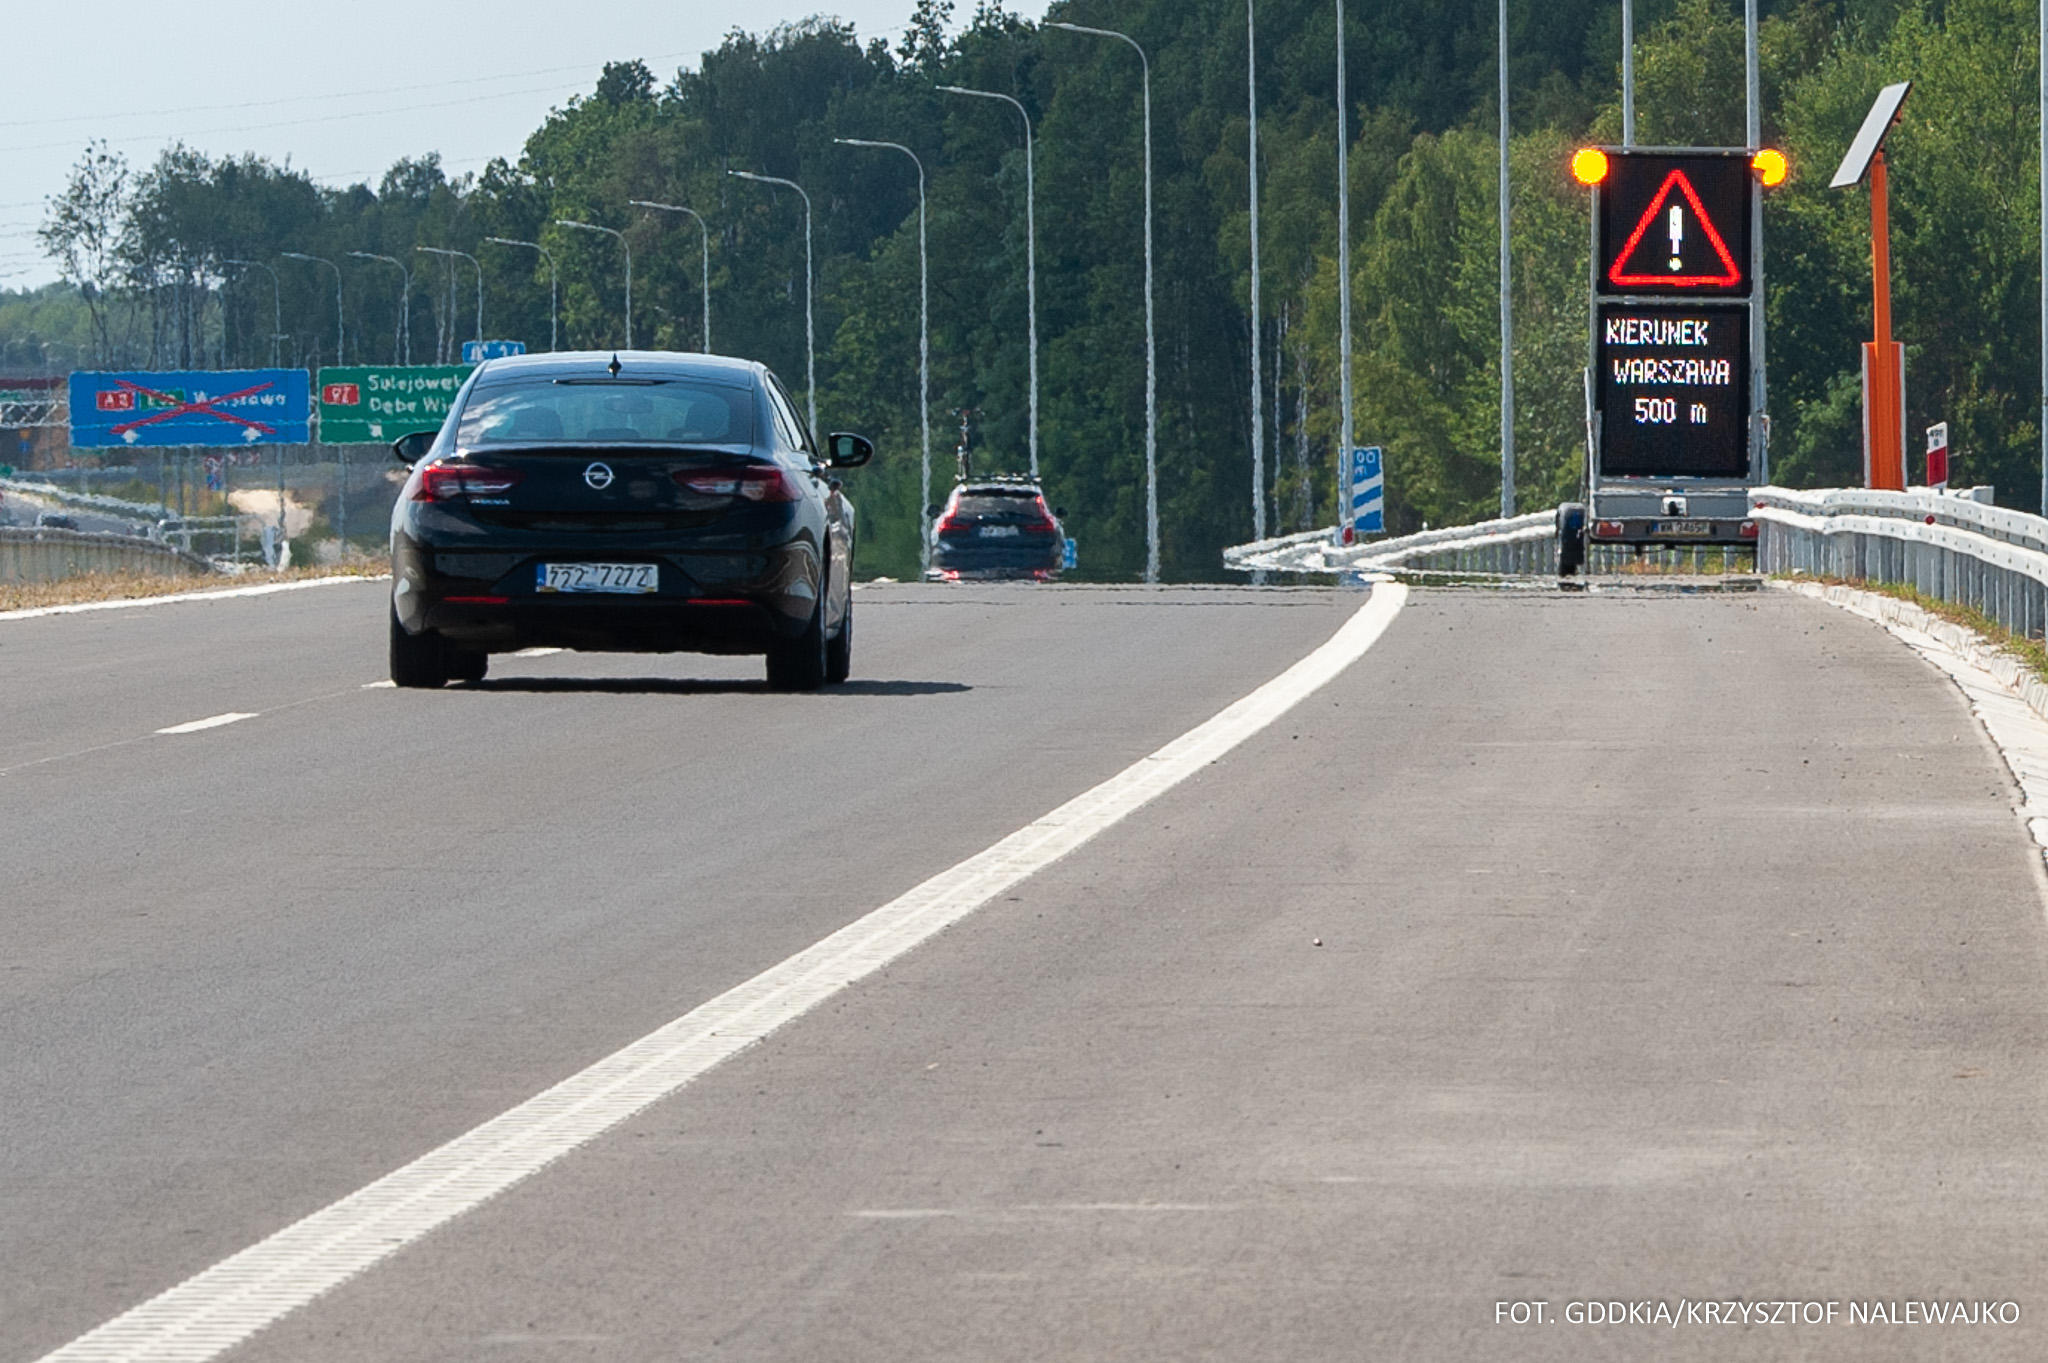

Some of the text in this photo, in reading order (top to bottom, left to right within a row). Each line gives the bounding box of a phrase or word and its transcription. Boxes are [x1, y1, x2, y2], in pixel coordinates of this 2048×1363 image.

[1605, 318, 1709, 346] KIERUNEK
[1613, 358, 1730, 385] WARSZAWA
[1634, 398, 1707, 424] 500 m
[1354, 451, 1376, 464] 00
